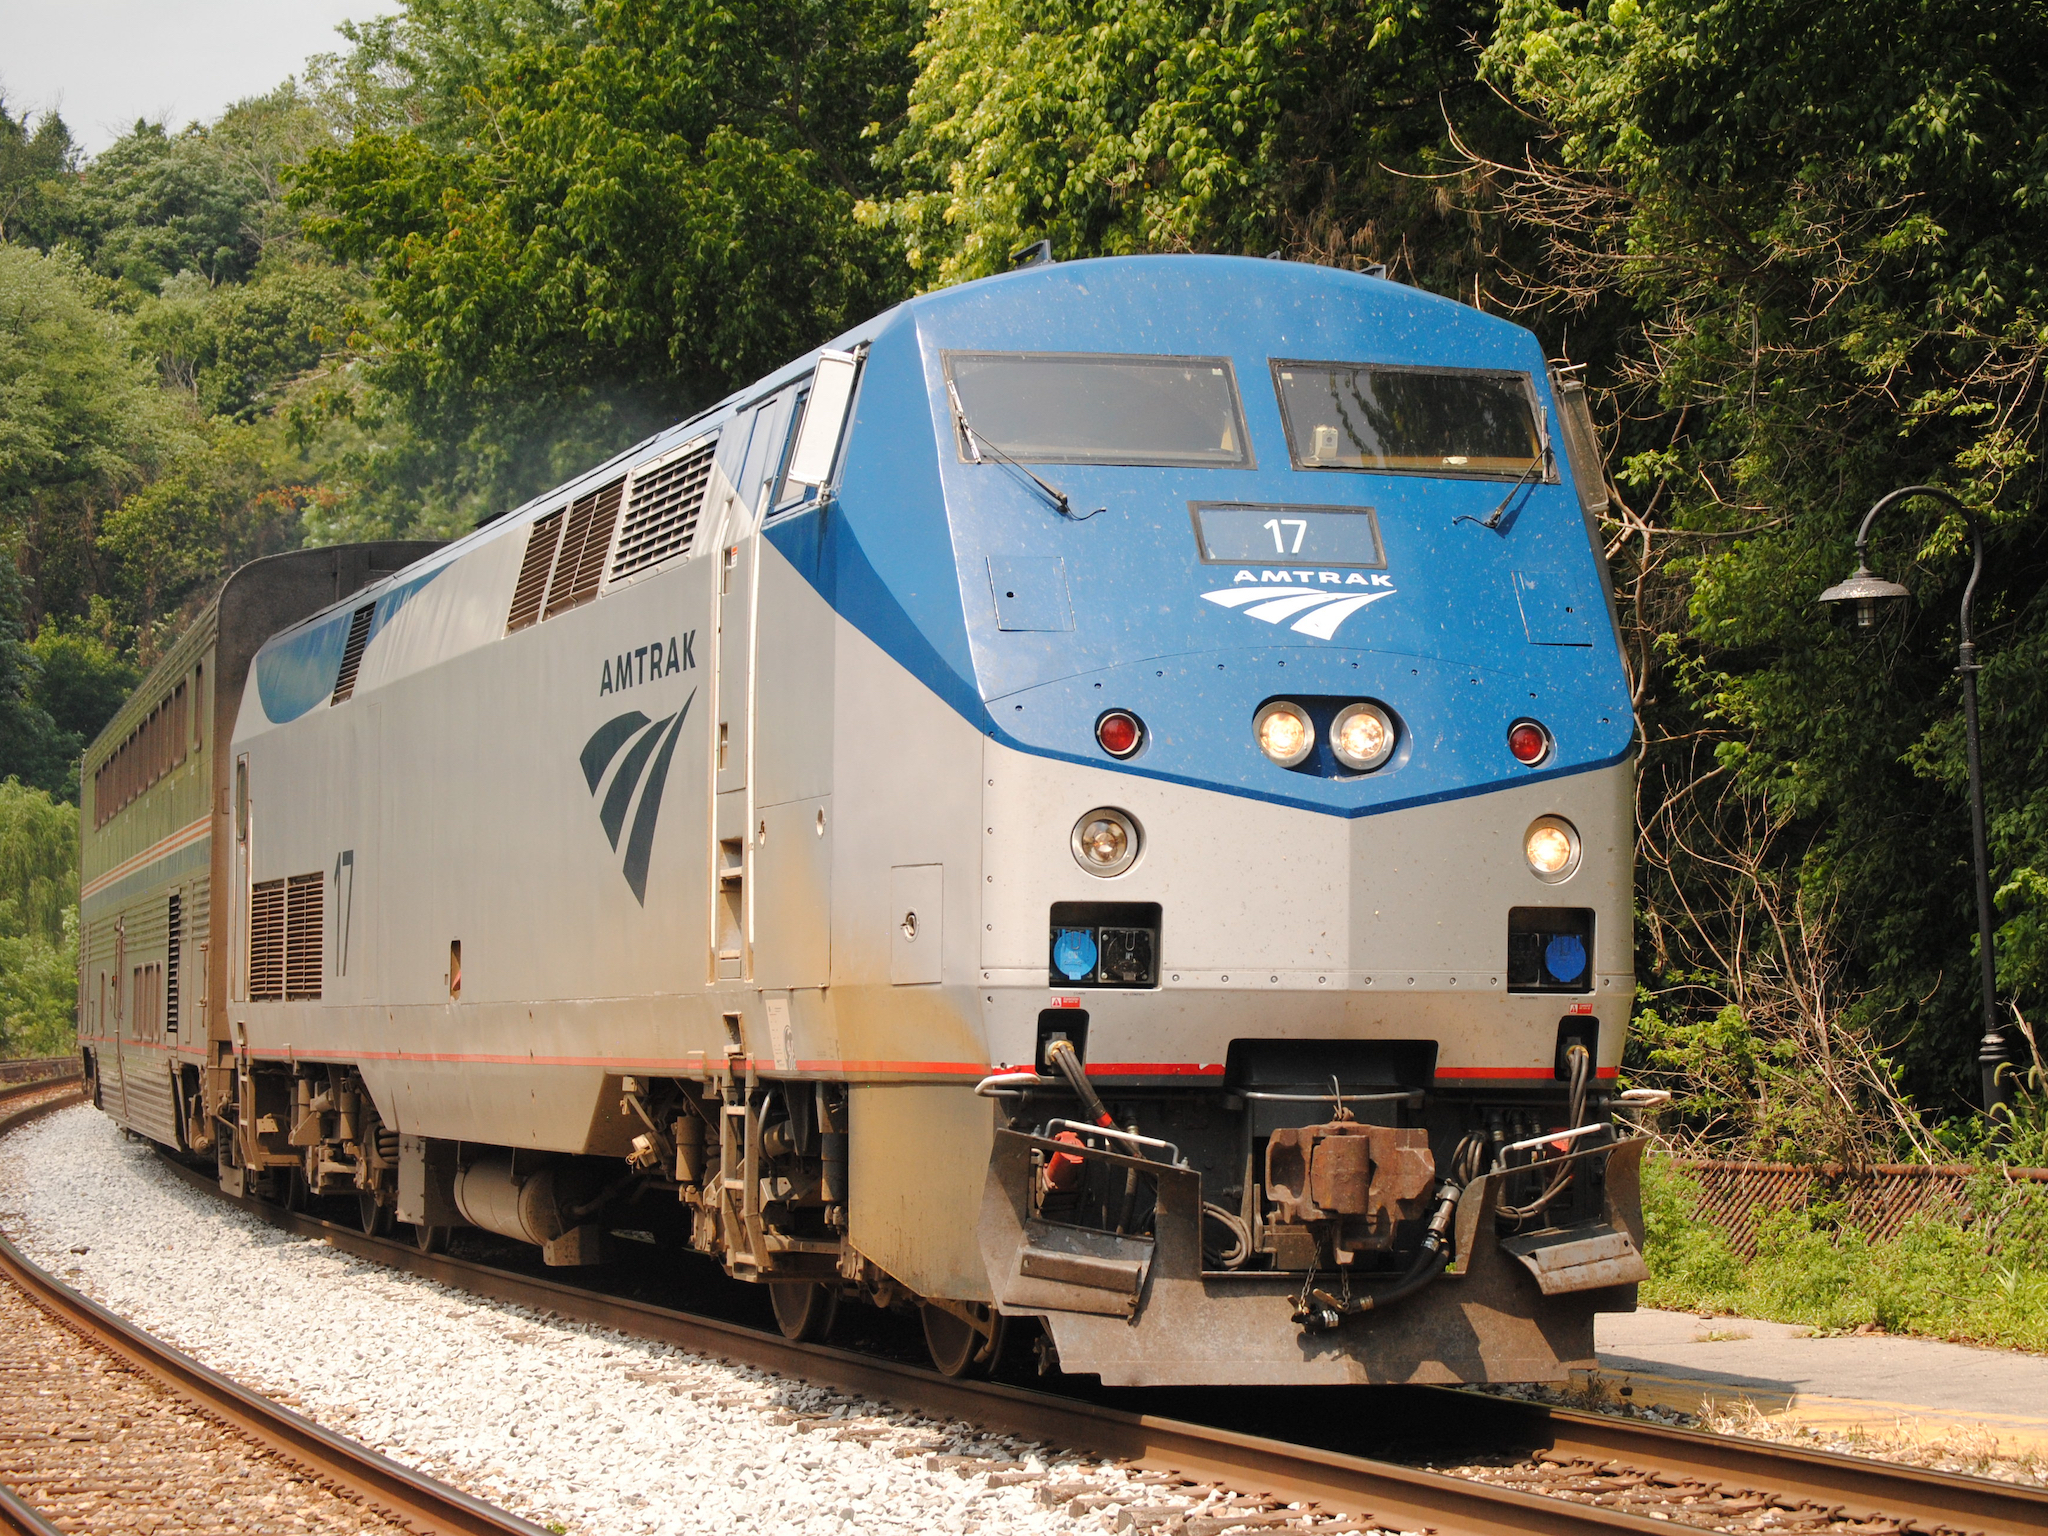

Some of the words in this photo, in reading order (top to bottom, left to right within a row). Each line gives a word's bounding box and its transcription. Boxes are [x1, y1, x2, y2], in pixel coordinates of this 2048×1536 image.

[1263, 519, 1307, 553] 17
[1233, 569, 1394, 587] AMTRAK
[600, 629, 696, 697] AMTRAK
[334, 850, 354, 977] 17
